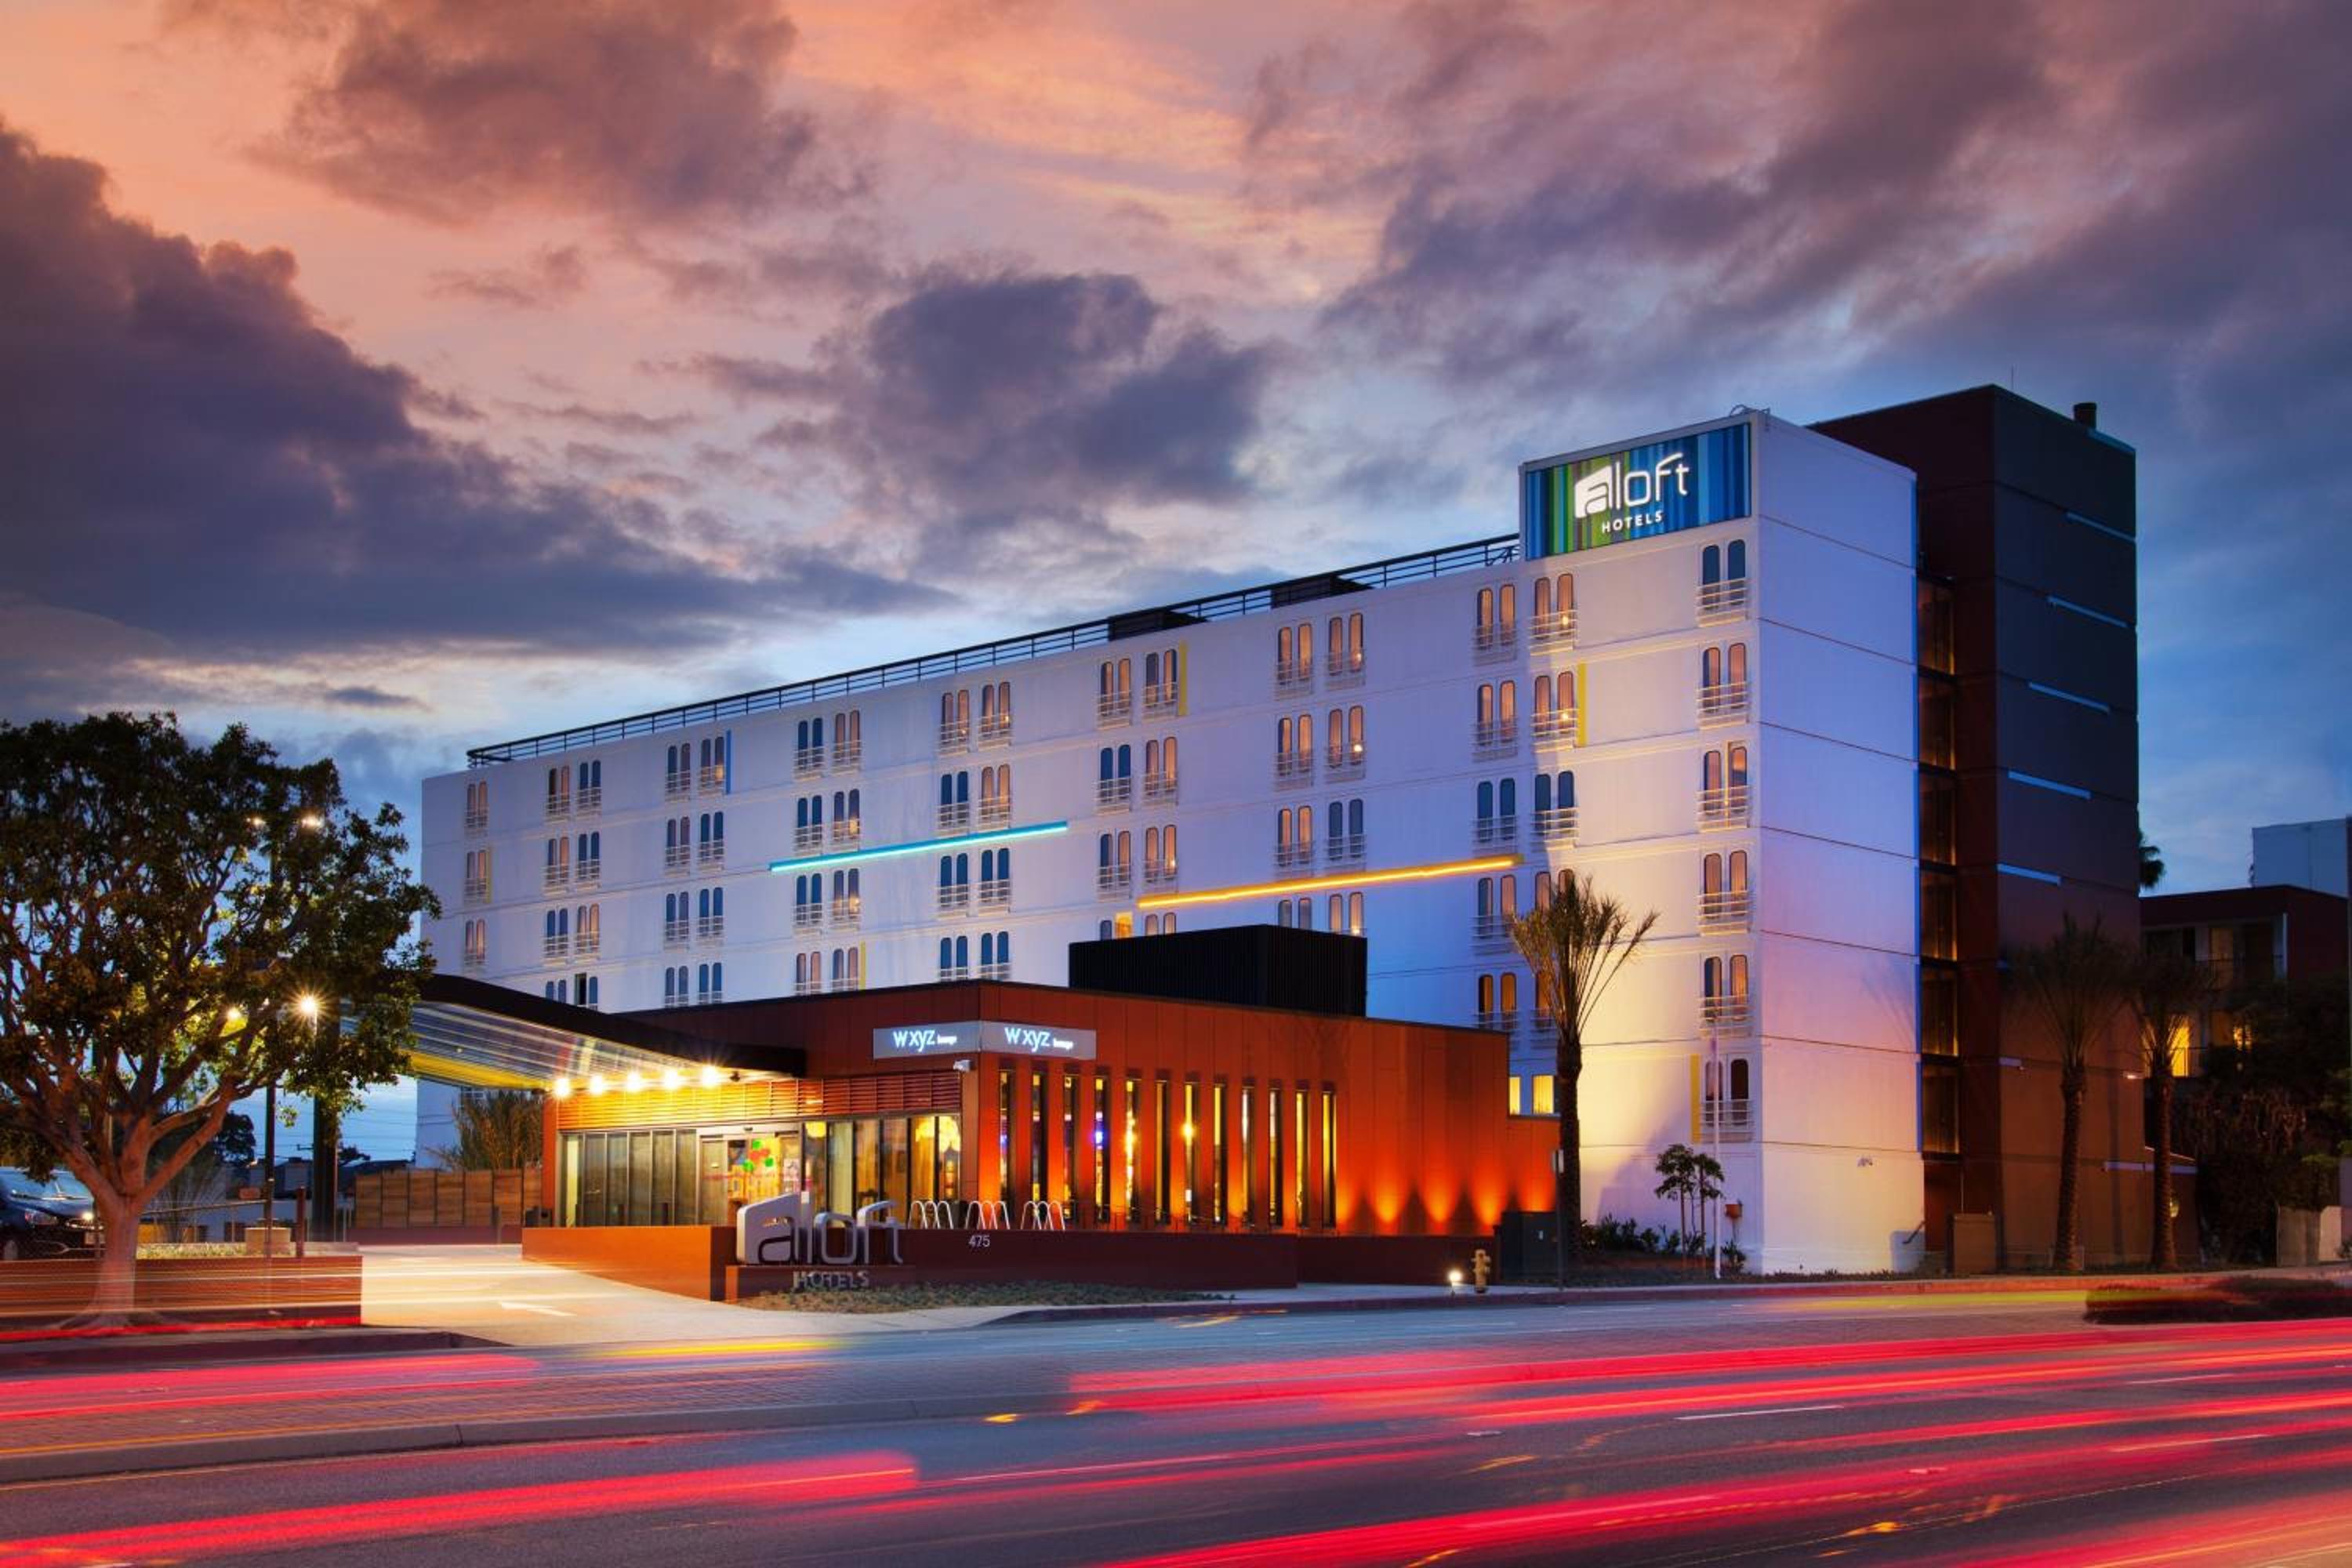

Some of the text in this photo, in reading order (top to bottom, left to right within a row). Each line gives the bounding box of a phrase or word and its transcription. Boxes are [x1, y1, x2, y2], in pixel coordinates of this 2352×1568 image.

[1574, 452, 1690, 519] aloft
[1601, 510, 1664, 534] HOTELS
[736, 1190, 905, 1265] aloft
[968, 1235, 990, 1247] 475
